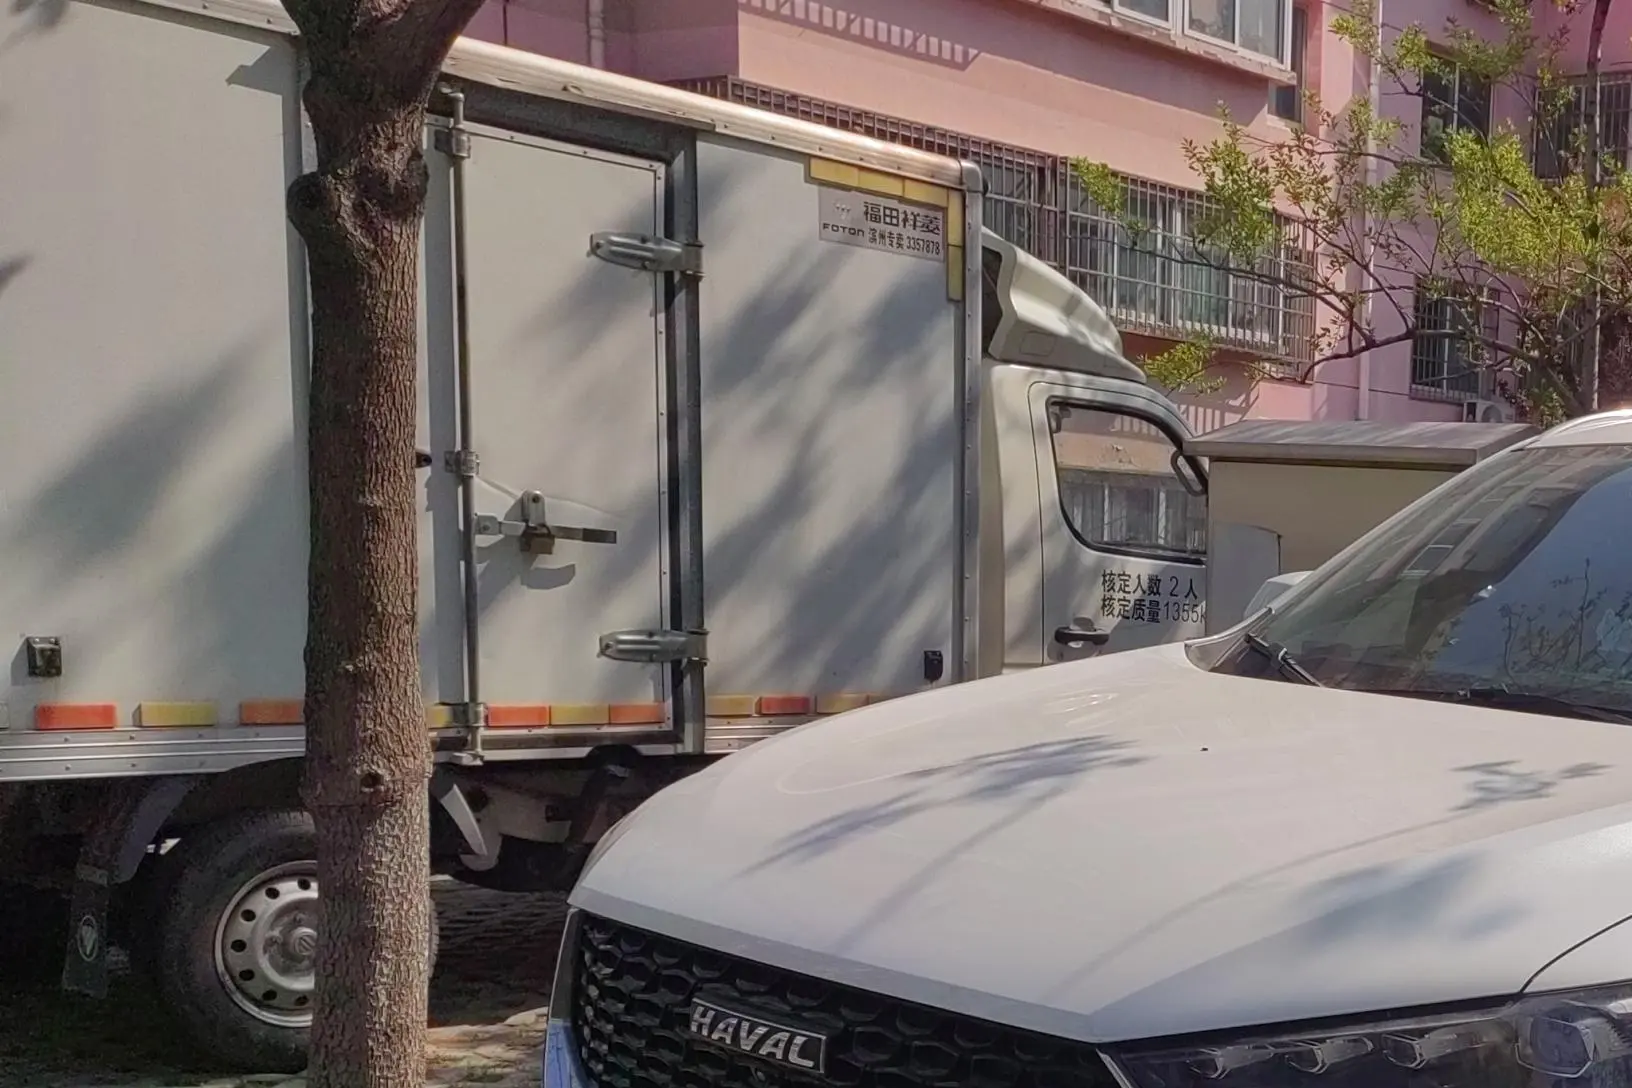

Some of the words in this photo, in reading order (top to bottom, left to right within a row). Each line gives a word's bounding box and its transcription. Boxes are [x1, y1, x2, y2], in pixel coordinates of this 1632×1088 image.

[863, 201, 941, 236] 福田祥菱
[906, 235, 941, 256] 3357878
[1101, 569, 1162, 597] 核定人数
[1169, 576, 1179, 597] 2
[1184, 578, 1198, 600] 人
[690, 1006, 815, 1068] HAVAL
